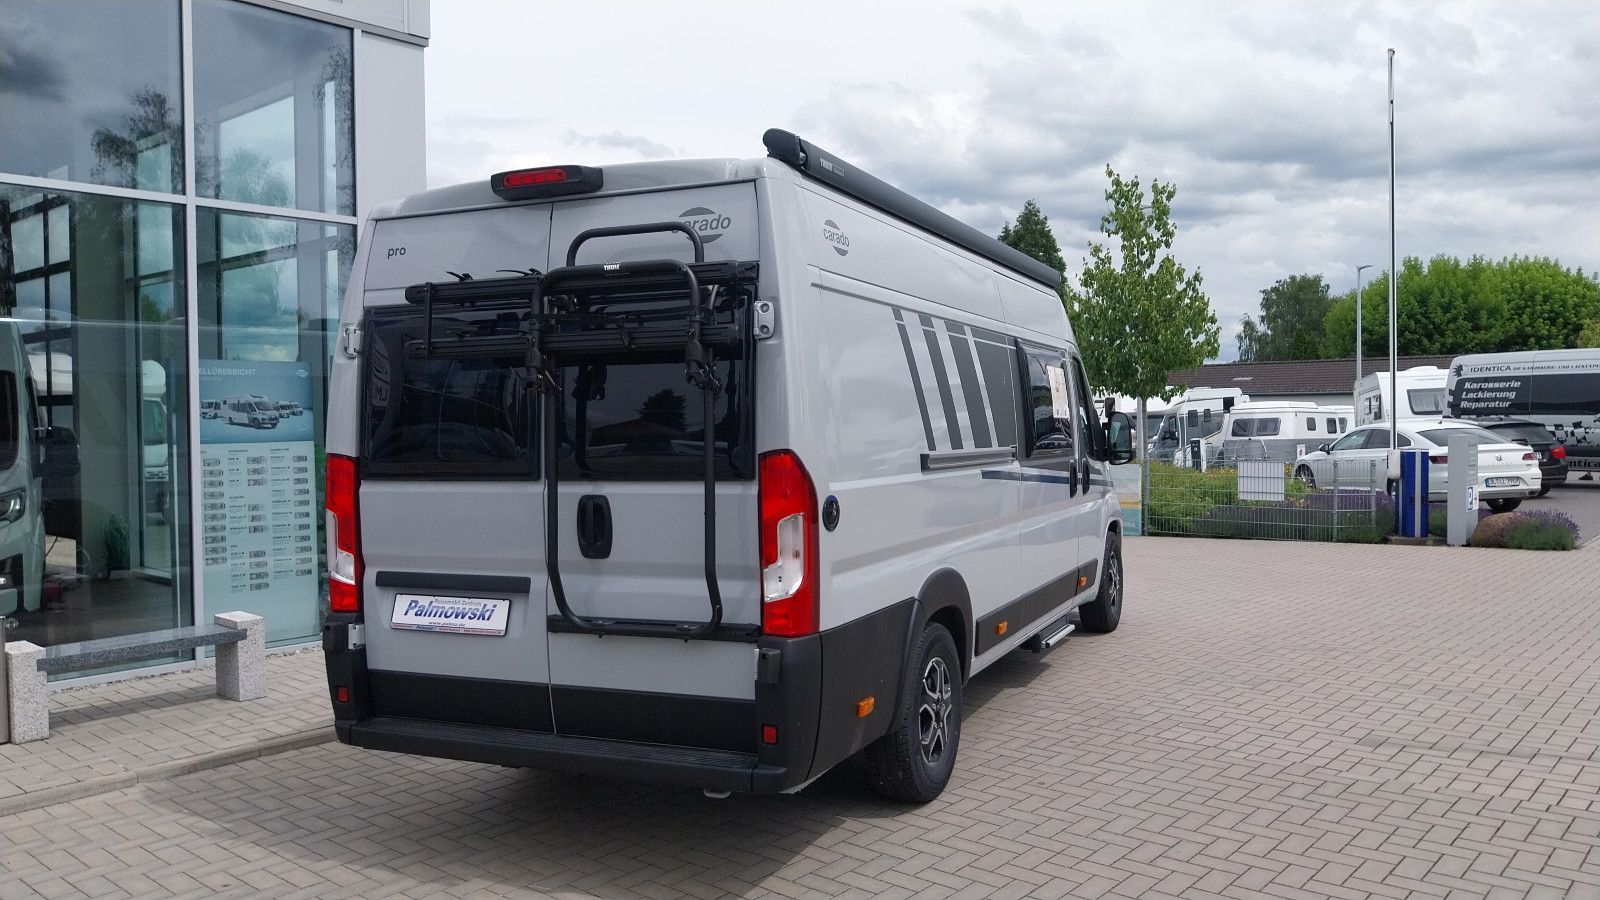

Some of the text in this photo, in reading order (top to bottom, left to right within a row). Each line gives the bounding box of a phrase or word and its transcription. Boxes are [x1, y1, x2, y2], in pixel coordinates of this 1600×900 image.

[672, 214, 732, 233] arado
[823, 228, 850, 247] carado
[387, 247, 406, 260] pro
[1470, 365, 1512, 373] IDENTICA
[1464, 380, 1521, 389] Karosserie
[1462, 390, 1517, 399] Lackierung
[1460, 401, 1512, 409] Reparatur
[404, 600, 497, 621] Palmowski
